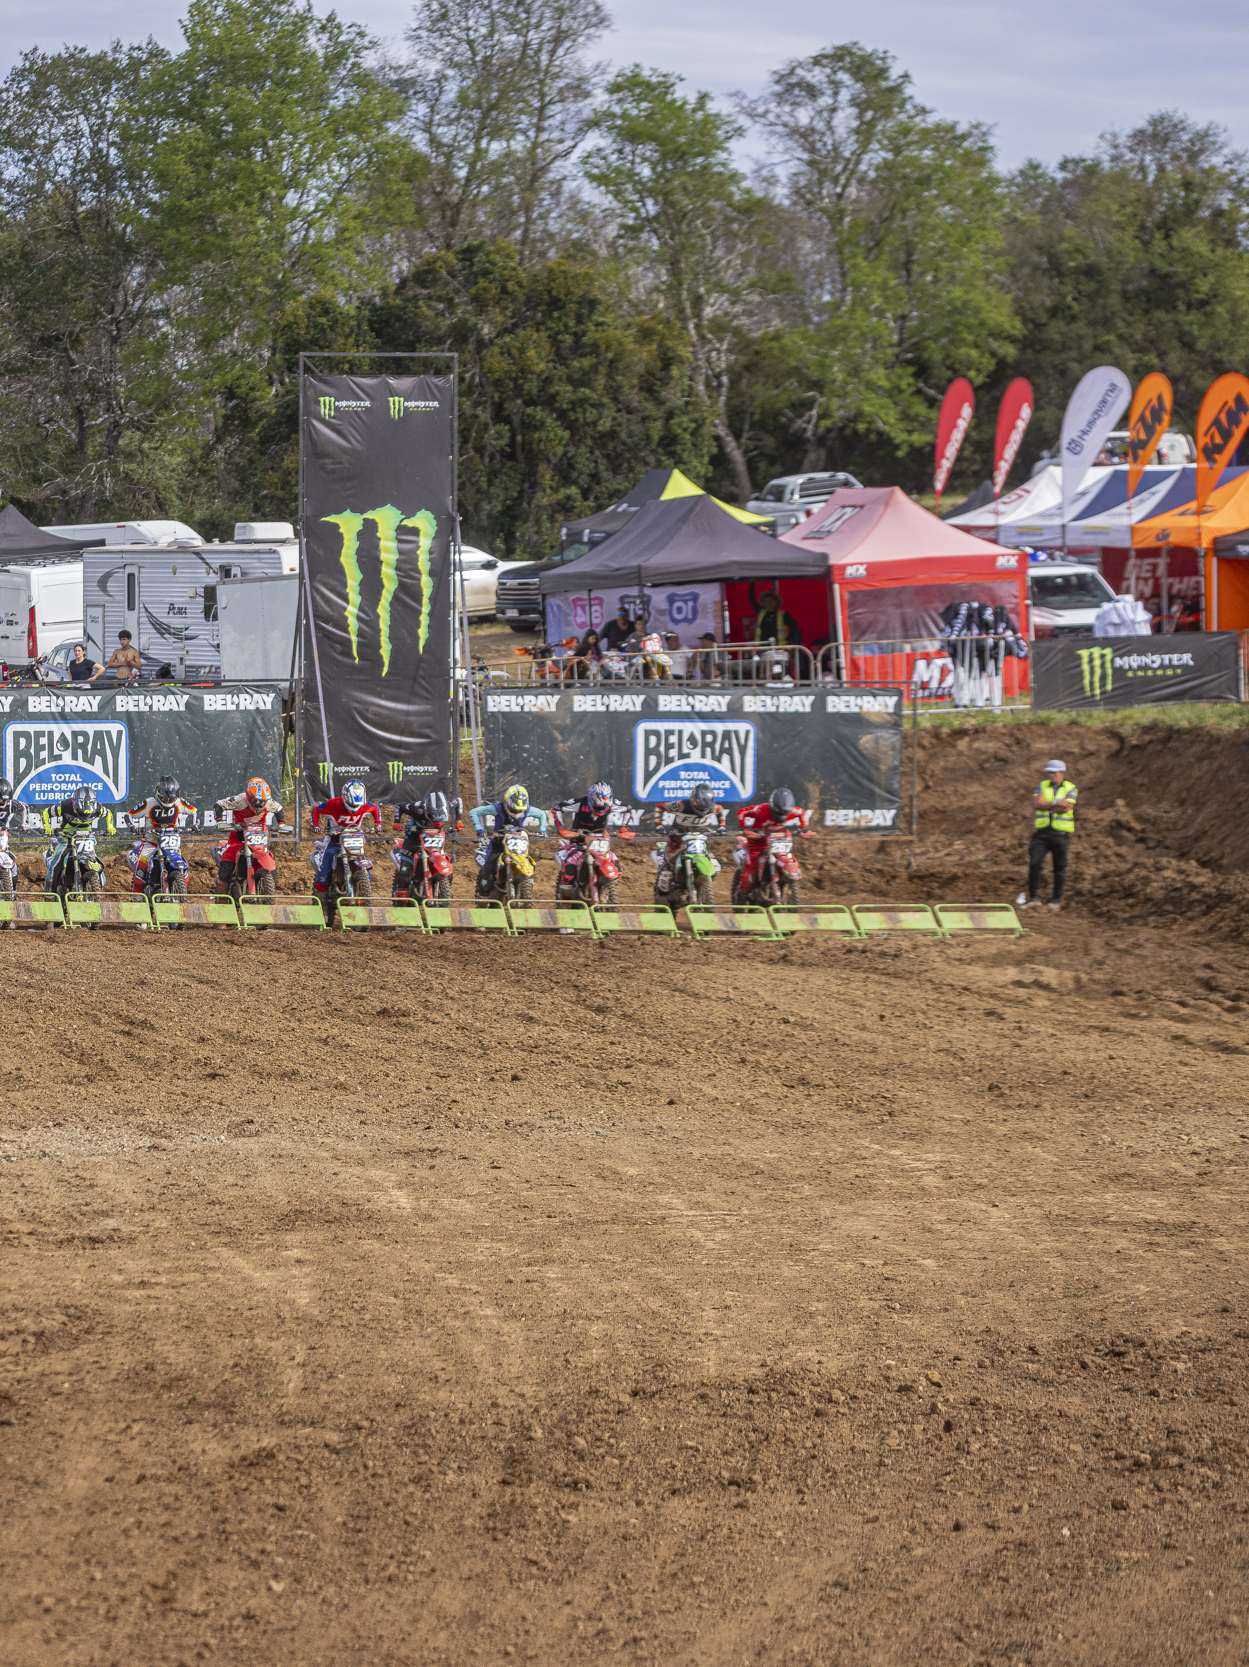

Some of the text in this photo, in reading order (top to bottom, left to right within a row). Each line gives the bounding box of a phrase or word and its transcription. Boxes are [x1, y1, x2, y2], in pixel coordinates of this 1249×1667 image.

[1077, 382, 1118, 441] Husqvarna
[1130, 392, 1168, 464] KTM
[1202, 391, 1249, 469] KTM
[1113, 652, 1195, 670] MONSTER
[1126, 668, 1182, 678] ENERGY
[334, 765, 370, 773] MONSTER
[403, 765, 438, 773] MONSTER
[51, 773, 82, 782] TOTAL
[680, 771, 711, 780] TOTAL
[155, 807, 175, 818] TLD
[337, 814, 361, 825] FLY
[77, 839, 95, 851] 78
[160, 836, 181, 848] 261
[424, 837, 445, 847] 227
[506, 839, 528, 850] 238
[589, 840, 610, 851] 49
